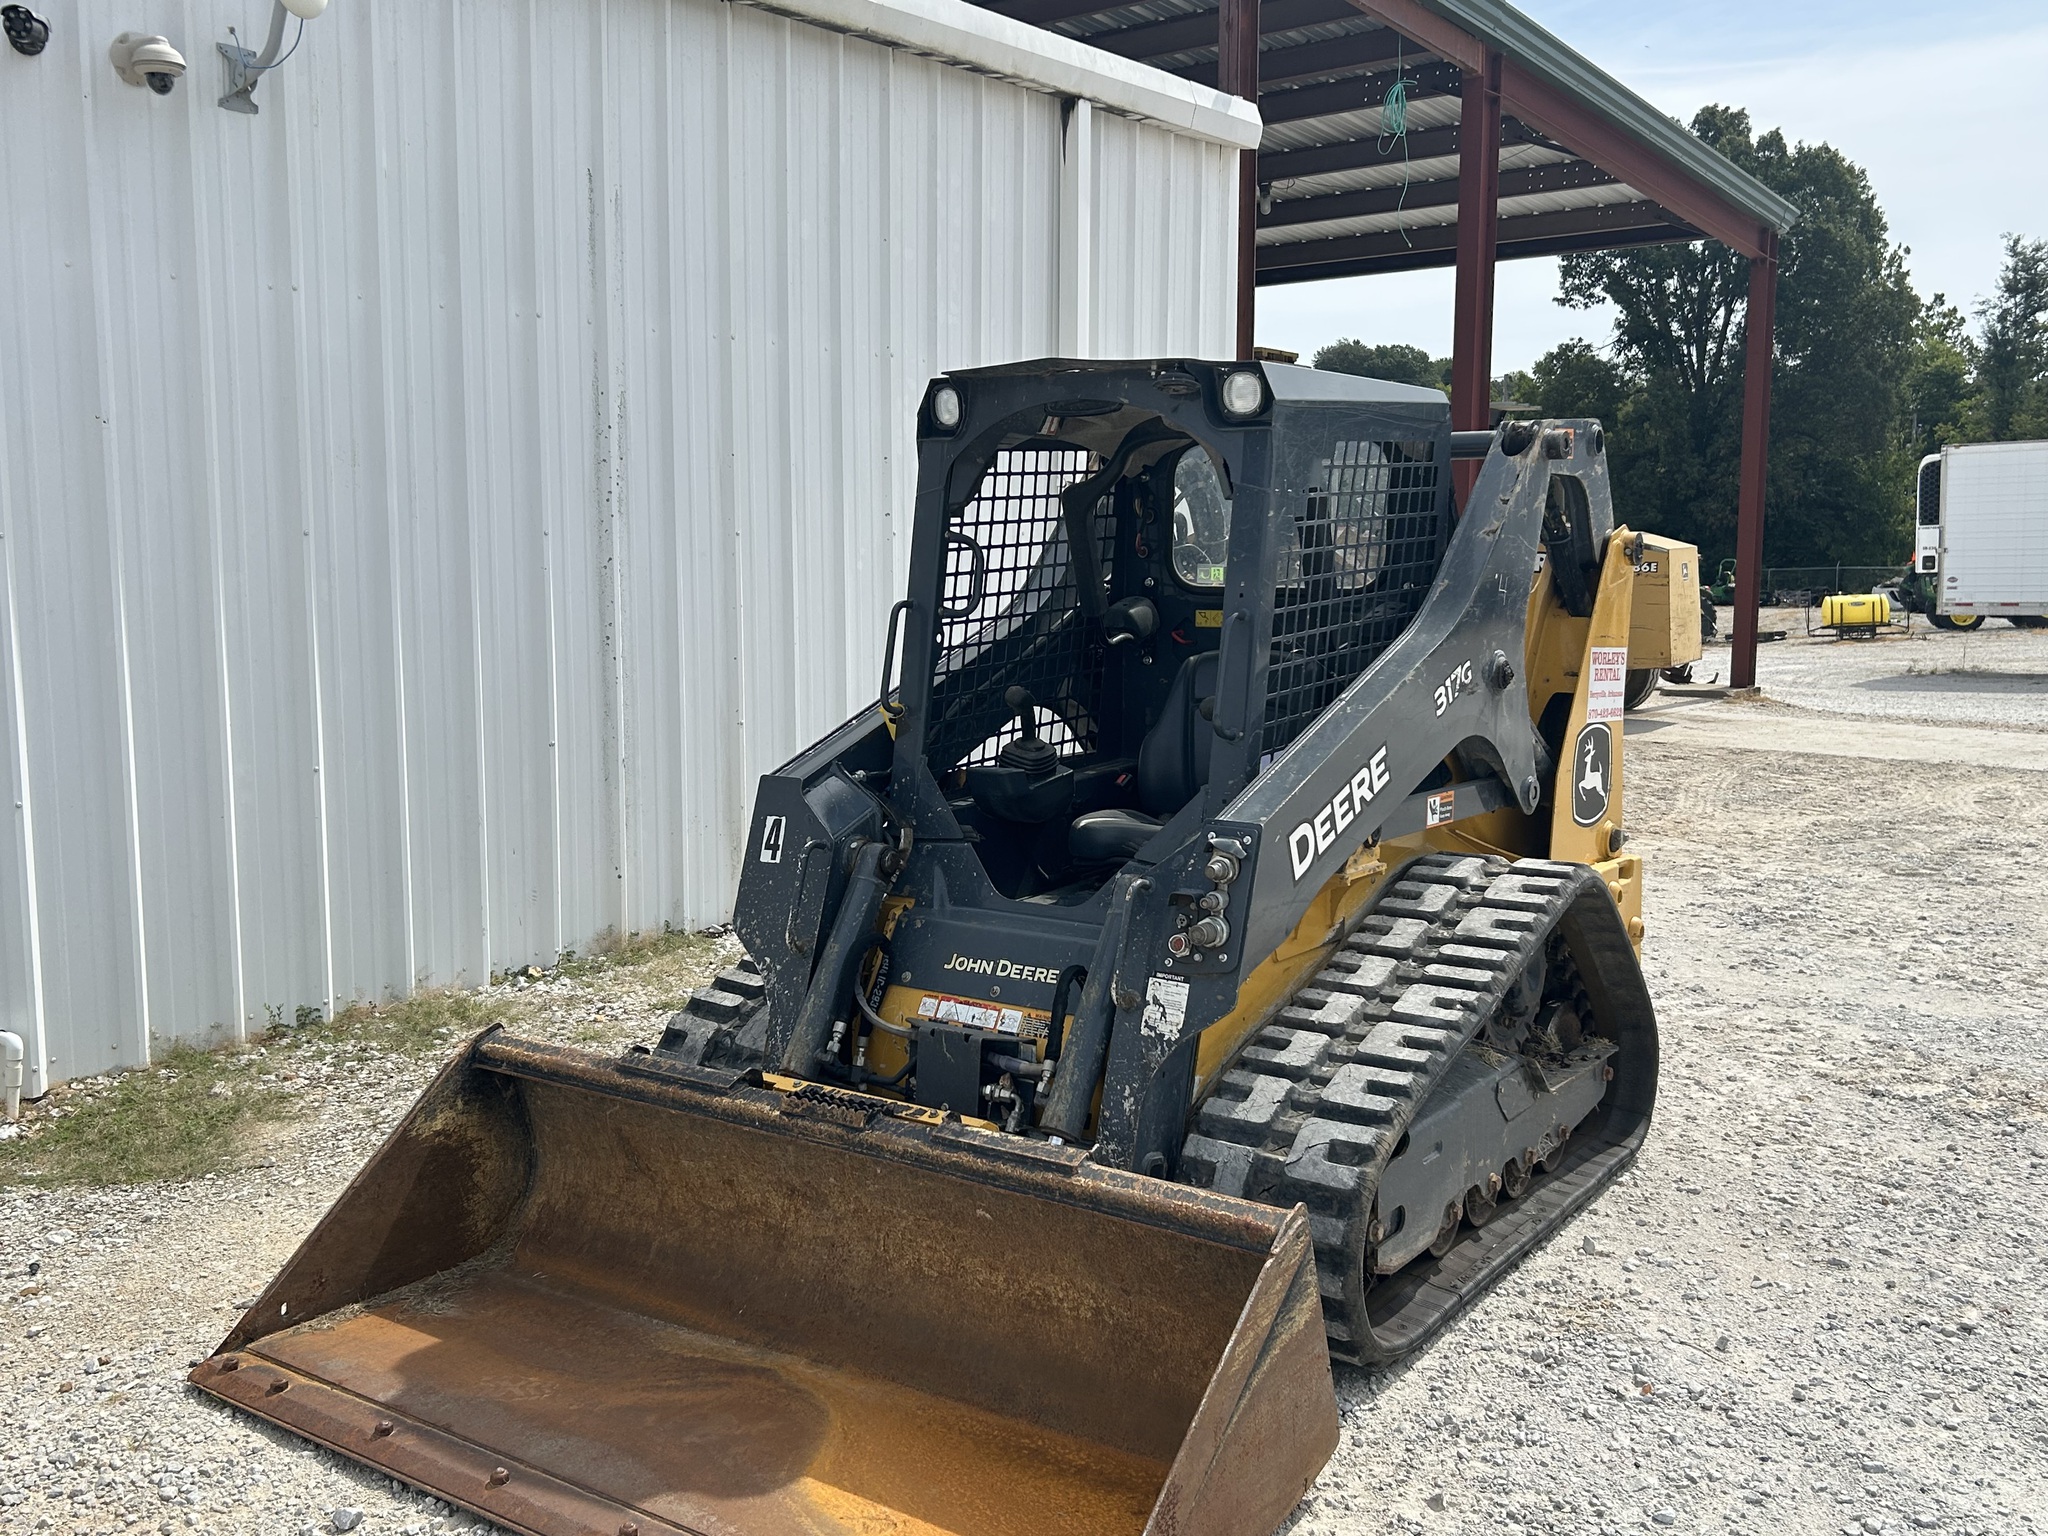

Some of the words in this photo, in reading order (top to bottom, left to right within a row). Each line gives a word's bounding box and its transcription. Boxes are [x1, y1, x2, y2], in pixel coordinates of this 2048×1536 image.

[1433, 660, 1472, 717] 317G
[1594, 668, 1620, 681] RENTAL
[1288, 745, 1391, 881] DEERE
[764, 817, 783, 861] 4
[943, 953, 995, 975] JOHN
[995, 959, 1060, 984] DEERE
[1155, 972, 1185, 982] IMPORTANT
